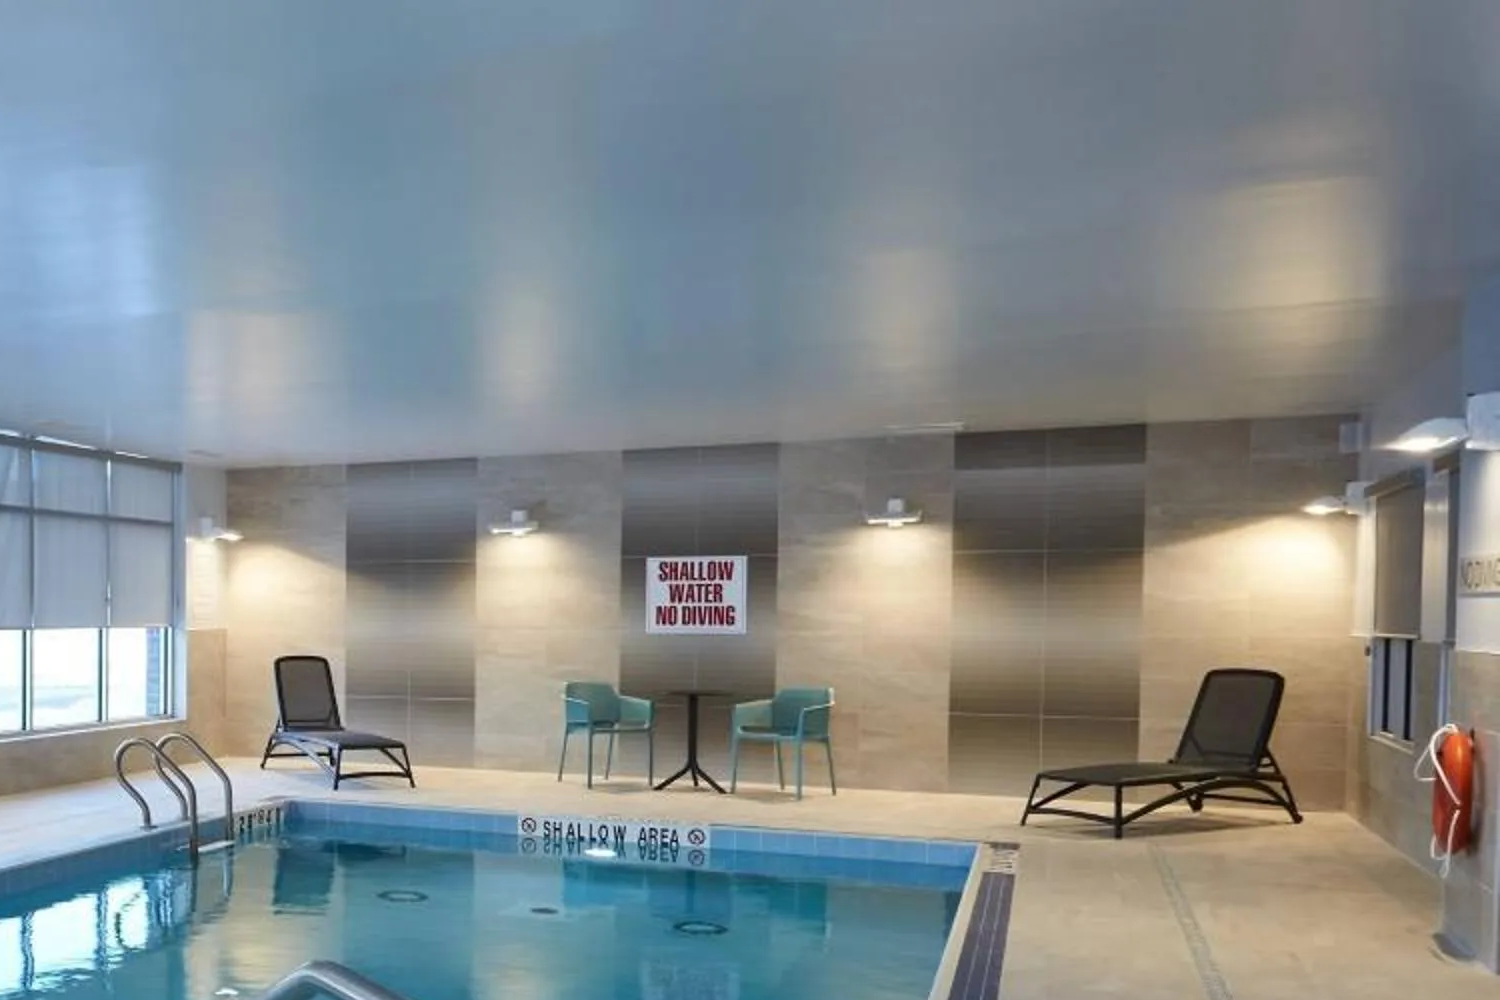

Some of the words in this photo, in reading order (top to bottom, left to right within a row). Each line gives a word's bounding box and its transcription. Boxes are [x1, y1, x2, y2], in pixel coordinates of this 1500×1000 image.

[658, 561, 734, 582] SHALLOW
[669, 583, 723, 604] WATER
[656, 605, 678, 626] NO
[681, 605, 736, 626] DIVING
[543, 821, 627, 843] SHALLOW
[637, 827, 681, 848] AREA
